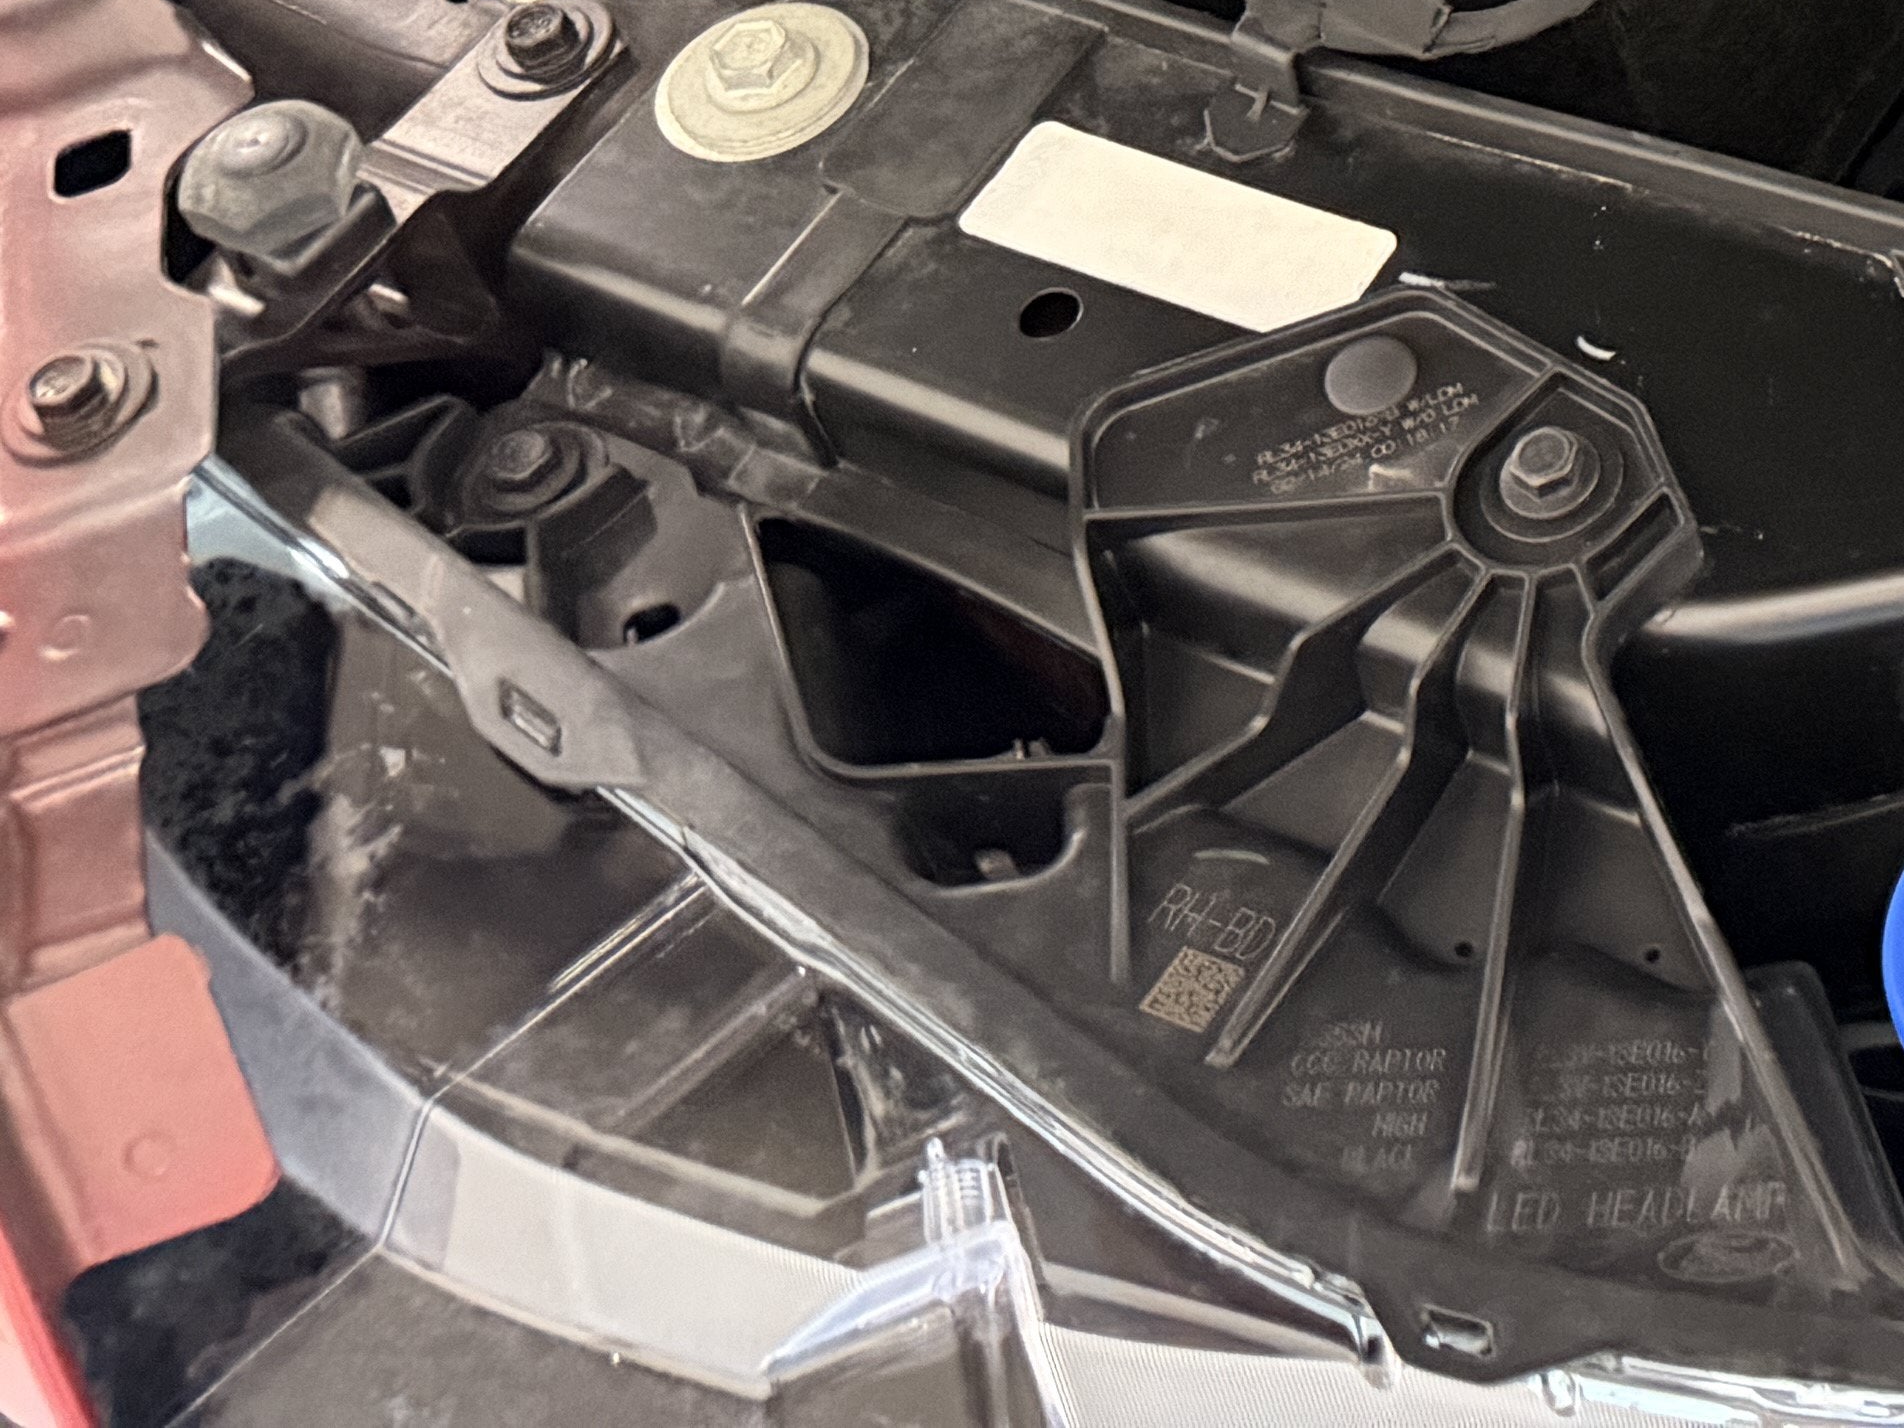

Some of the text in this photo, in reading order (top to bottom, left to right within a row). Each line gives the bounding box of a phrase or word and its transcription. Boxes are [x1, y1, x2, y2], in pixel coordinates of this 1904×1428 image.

[1442, 392, 1480, 416] LDM
[1148, 882, 1278, 961] RH-BD
[1352, 1049, 1448, 1074] RAPTOR
[1344, 1080, 1441, 1106] RAPTOR
[1485, 1180, 1787, 1234] LED HEADLAMP
